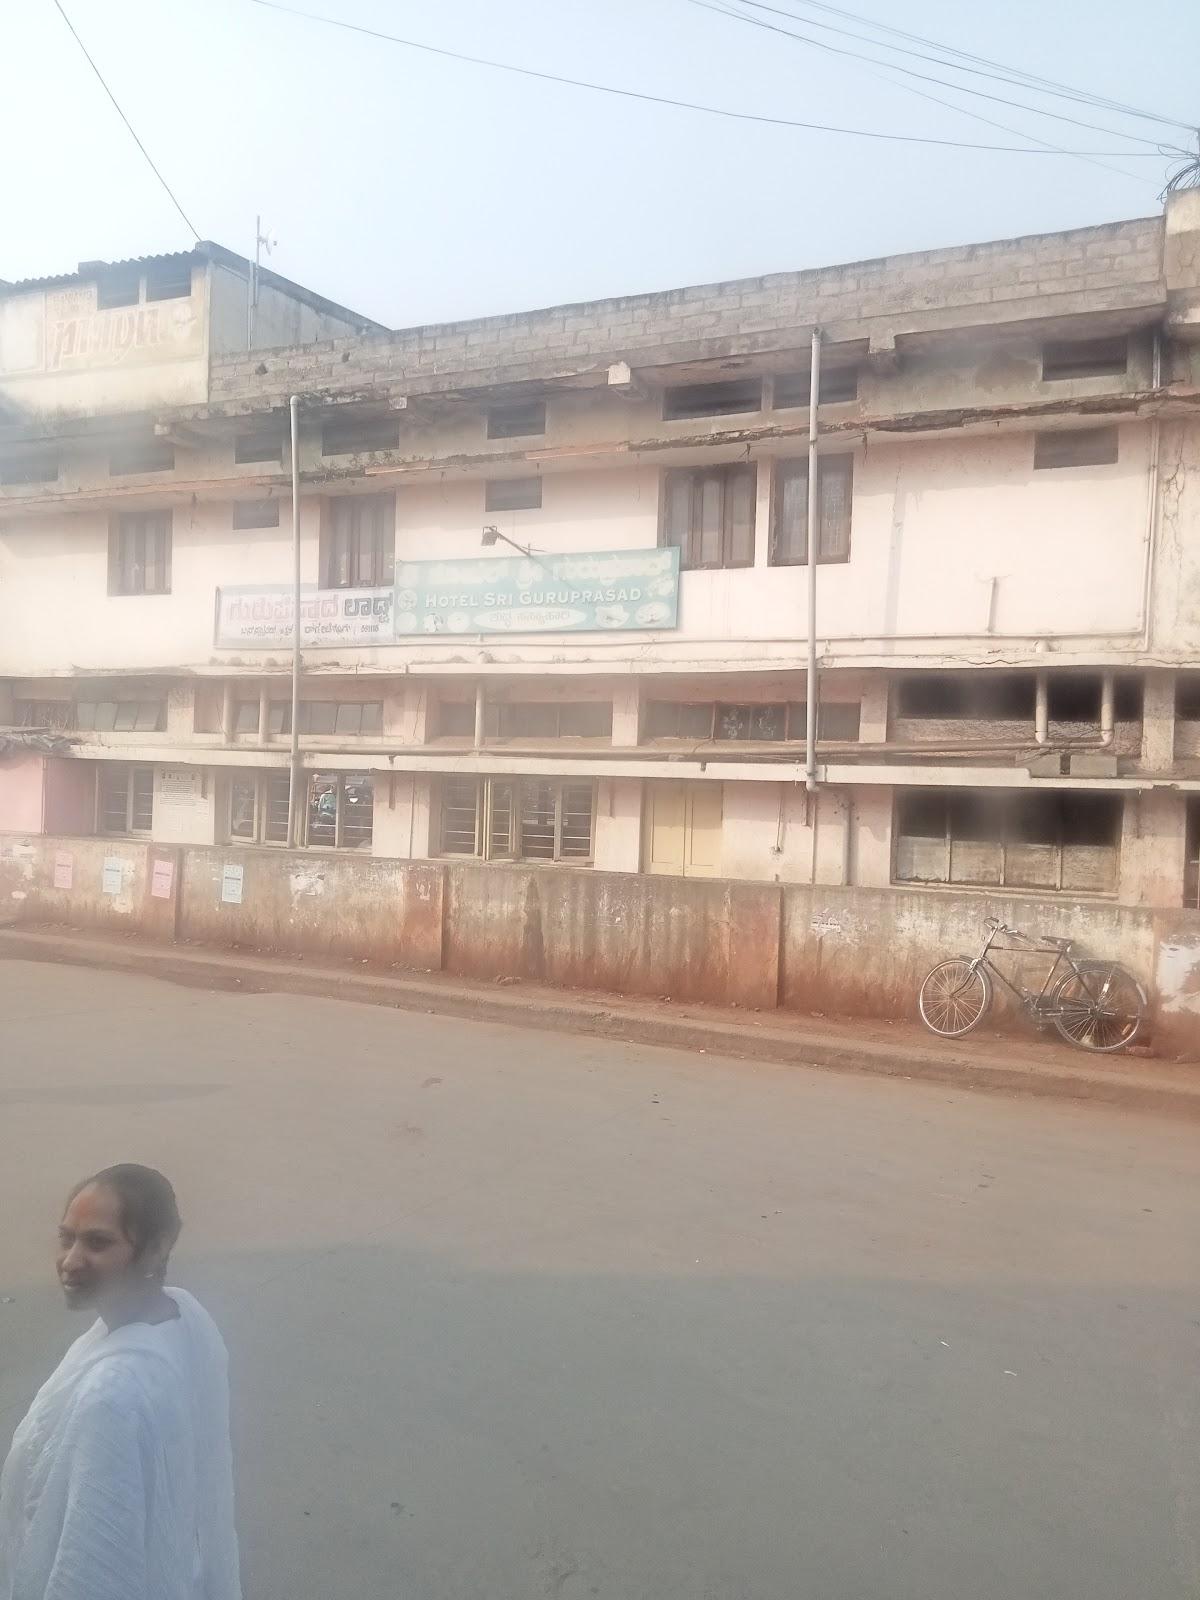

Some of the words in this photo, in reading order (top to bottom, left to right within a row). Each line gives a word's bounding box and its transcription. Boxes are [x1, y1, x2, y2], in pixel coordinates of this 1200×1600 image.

[424, 592, 479, 608] HOTEL
[484, 591, 513, 607] SRI
[519, 587, 642, 606] GURUPRASAD
